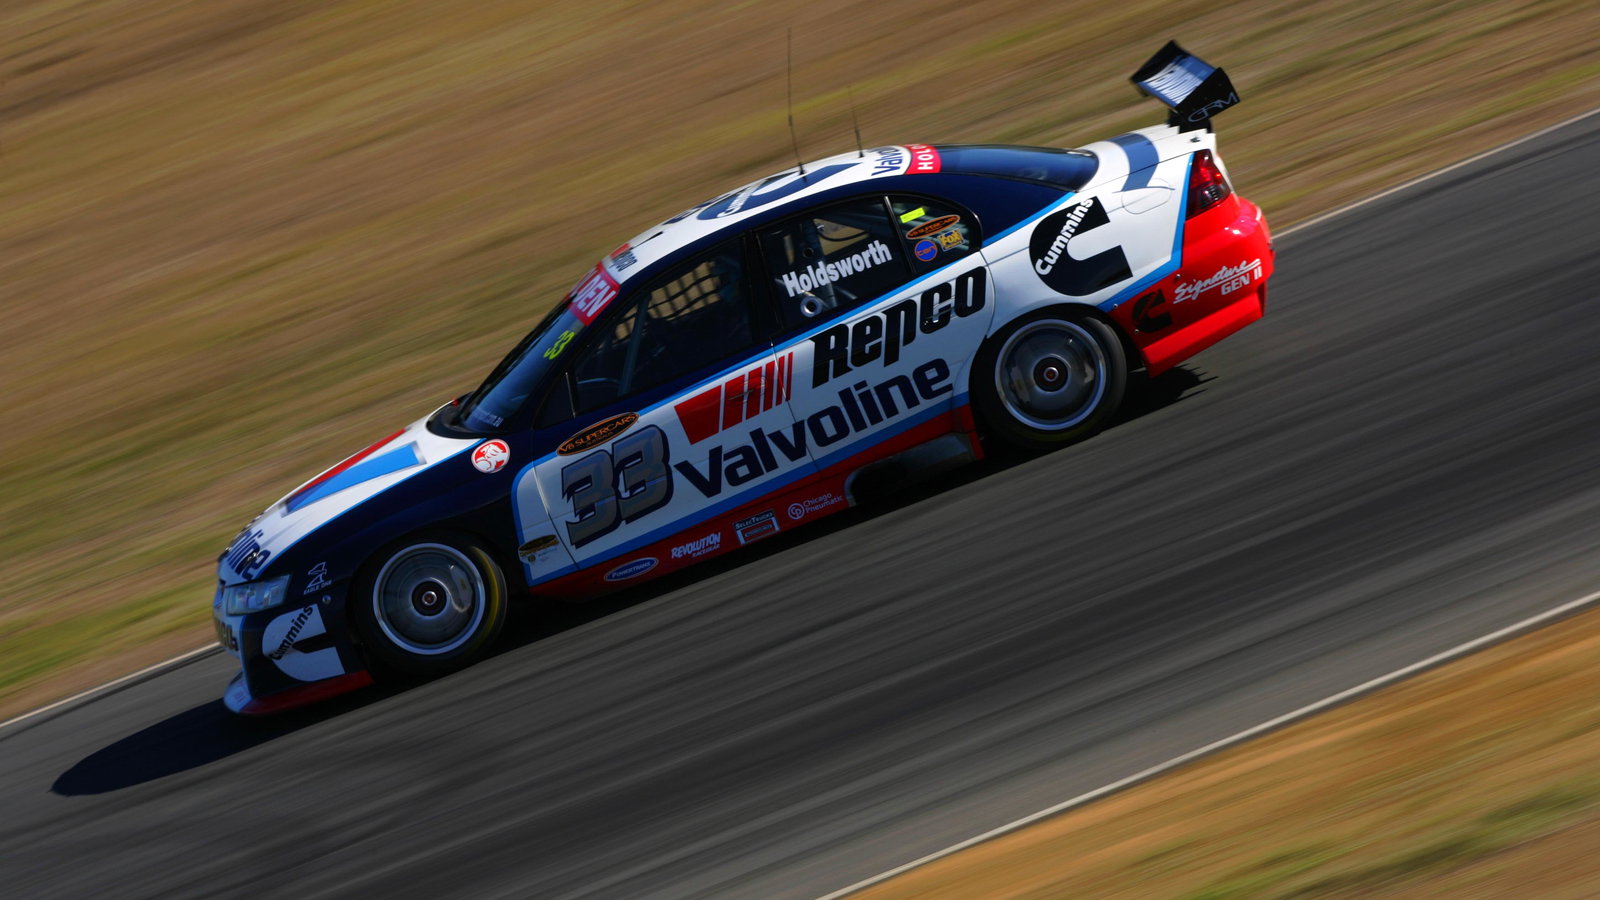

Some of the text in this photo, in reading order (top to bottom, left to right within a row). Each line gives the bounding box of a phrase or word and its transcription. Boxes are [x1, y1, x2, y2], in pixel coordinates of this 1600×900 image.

[1035, 198, 1094, 276] Cummins
[781, 240, 893, 298] Holdsworth
[1173, 258, 1262, 304] Signature
[1220, 273, 1250, 296] GEN
[543, 329, 576, 360] 33
[810, 266, 987, 389] Repco
[575, 413, 638, 445] SUPERCARS
[674, 358, 953, 498] Valvoline
[561, 424, 674, 550] 33
[803, 492, 832, 507] Chicago
[804, 496, 844, 514] Pneumatic
[671, 532, 721, 559] REVOLUTION
[272, 605, 314, 661] Cummins
